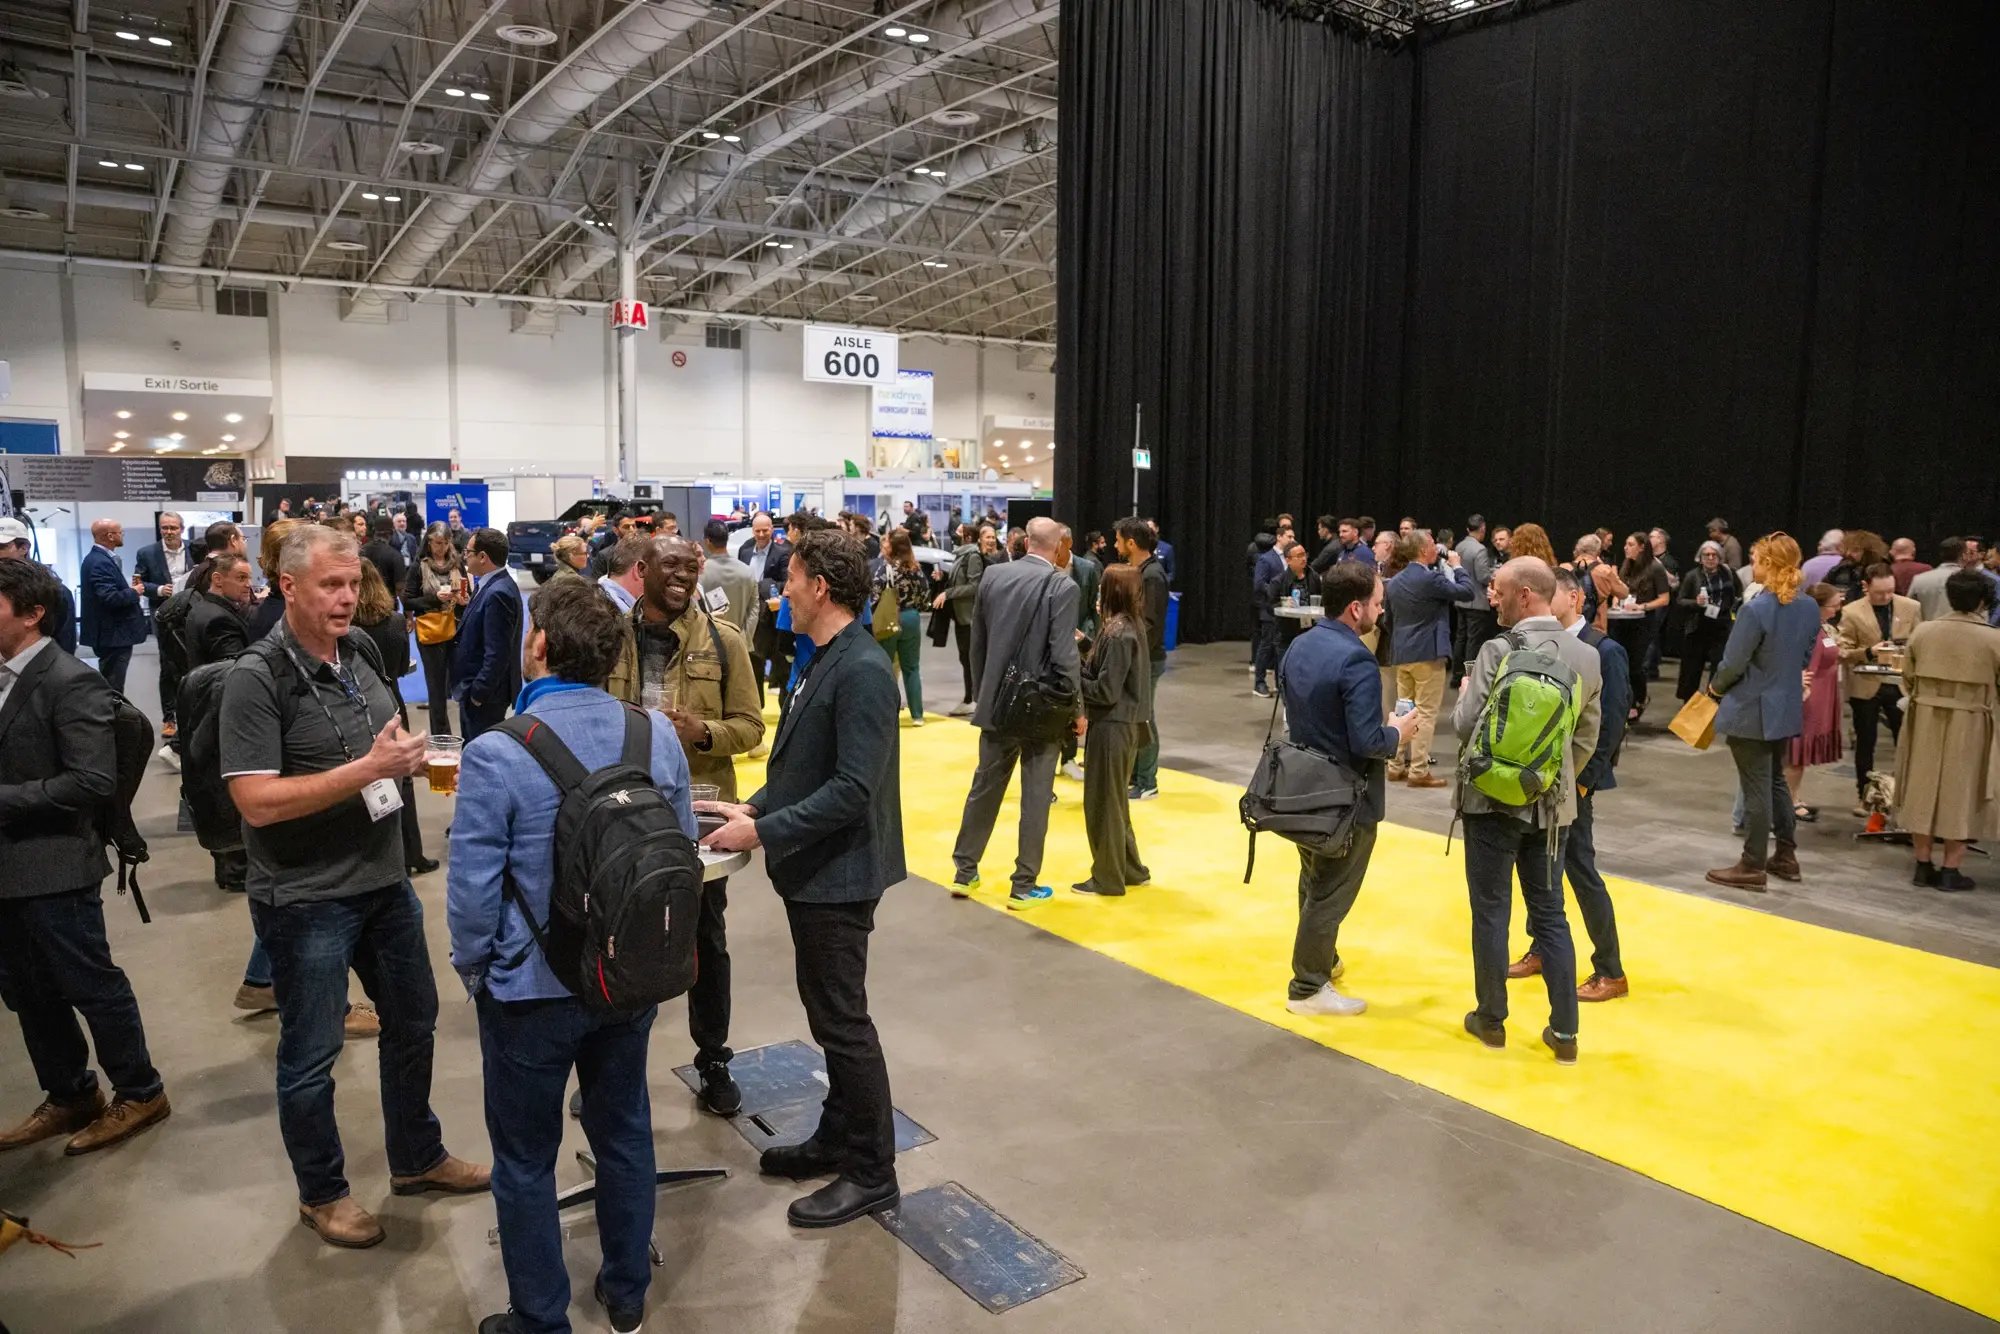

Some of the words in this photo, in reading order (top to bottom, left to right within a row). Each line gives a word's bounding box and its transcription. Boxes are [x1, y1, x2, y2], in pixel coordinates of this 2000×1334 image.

[614, 302, 623, 326] A
[631, 302, 647, 327] A
[834, 336, 872, 349] AISLE
[824, 350, 880, 379] 600
[410, 471, 448, 481] DELI
